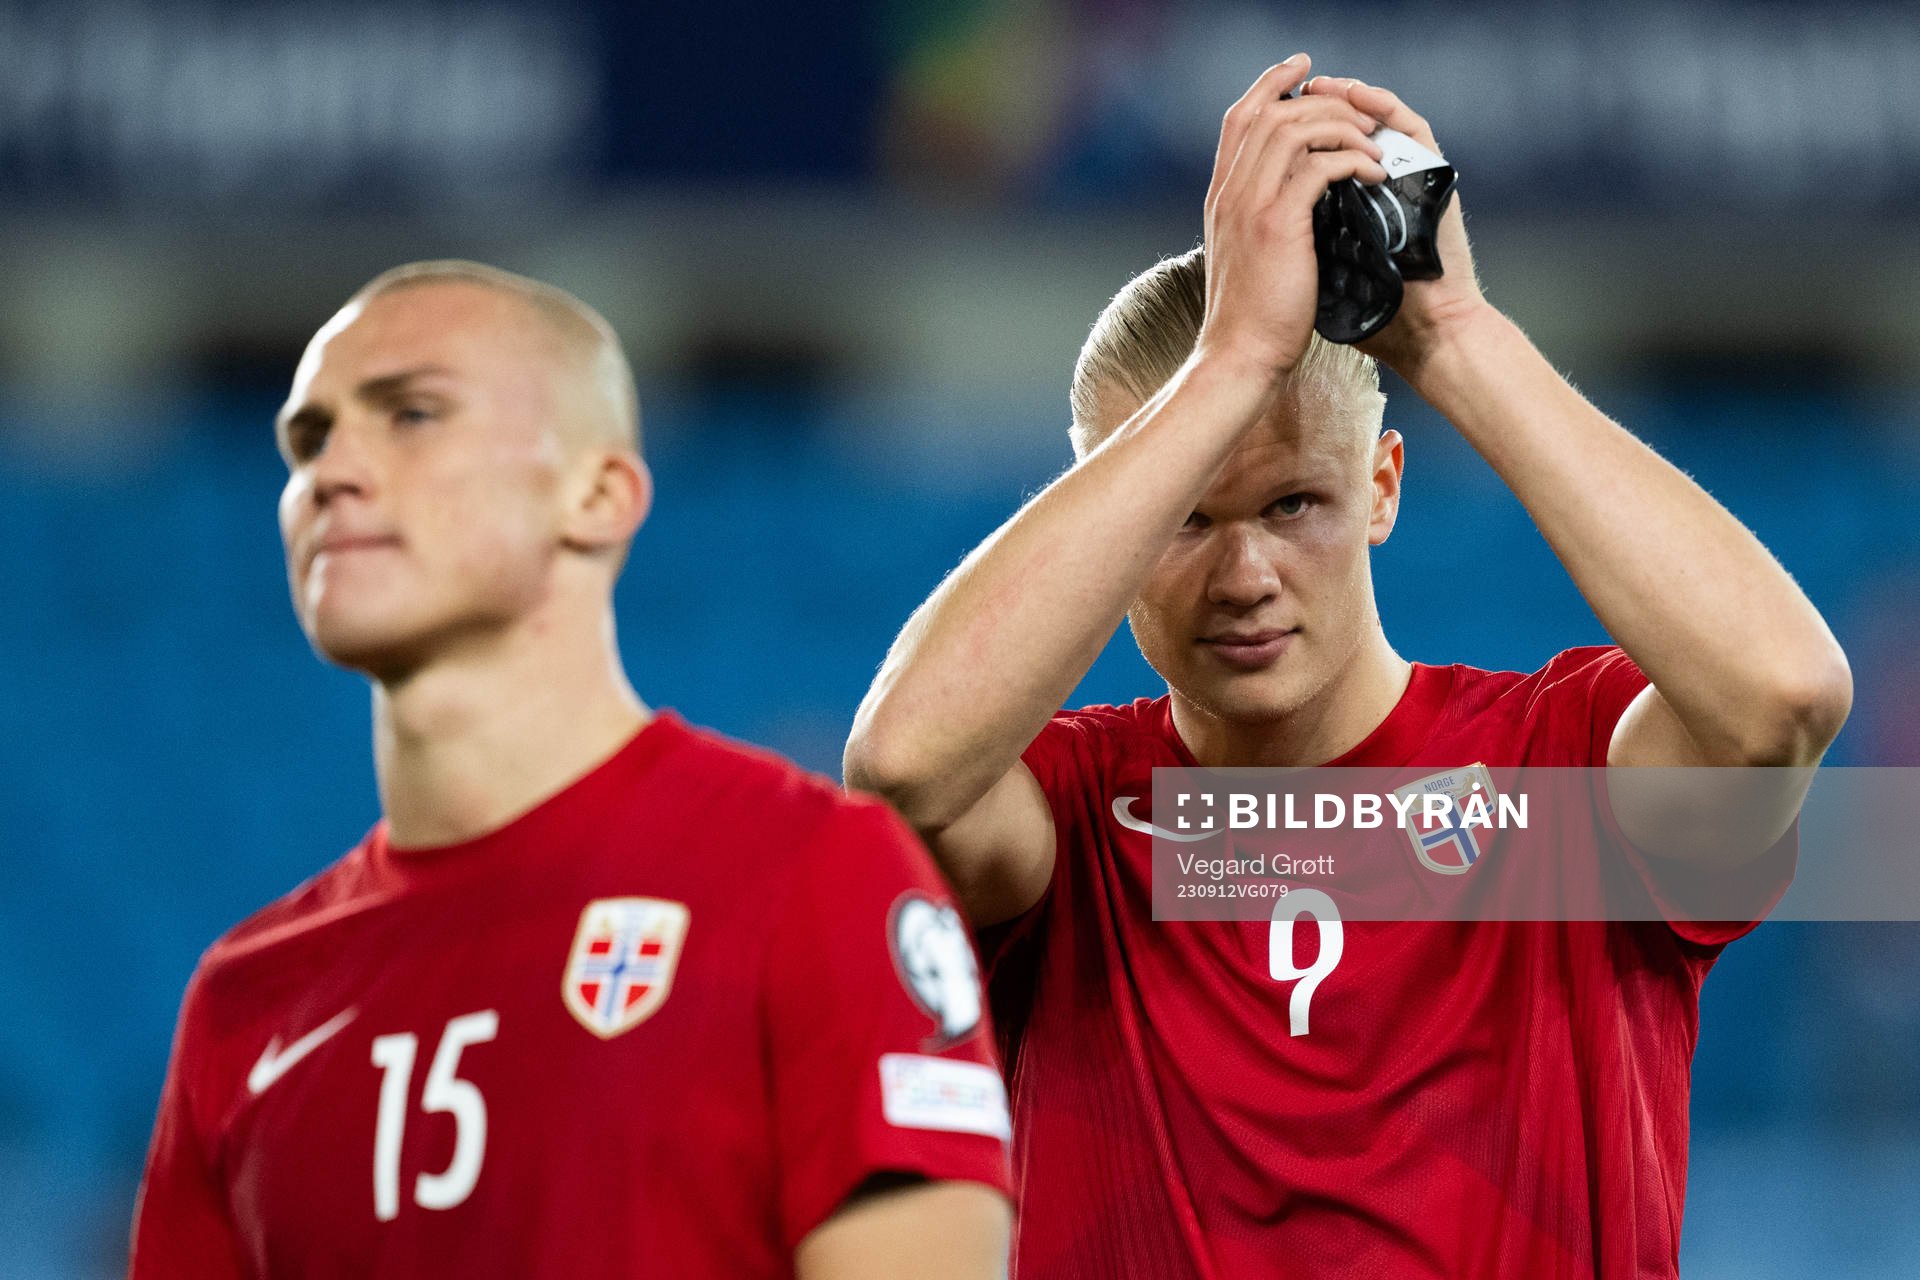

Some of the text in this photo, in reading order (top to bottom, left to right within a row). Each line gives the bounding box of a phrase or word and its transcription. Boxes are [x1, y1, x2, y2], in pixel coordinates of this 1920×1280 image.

[1424, 776, 1456, 793] NORGE
[1269, 888, 1344, 1037] 9
[371, 1009, 499, 1222] 15
